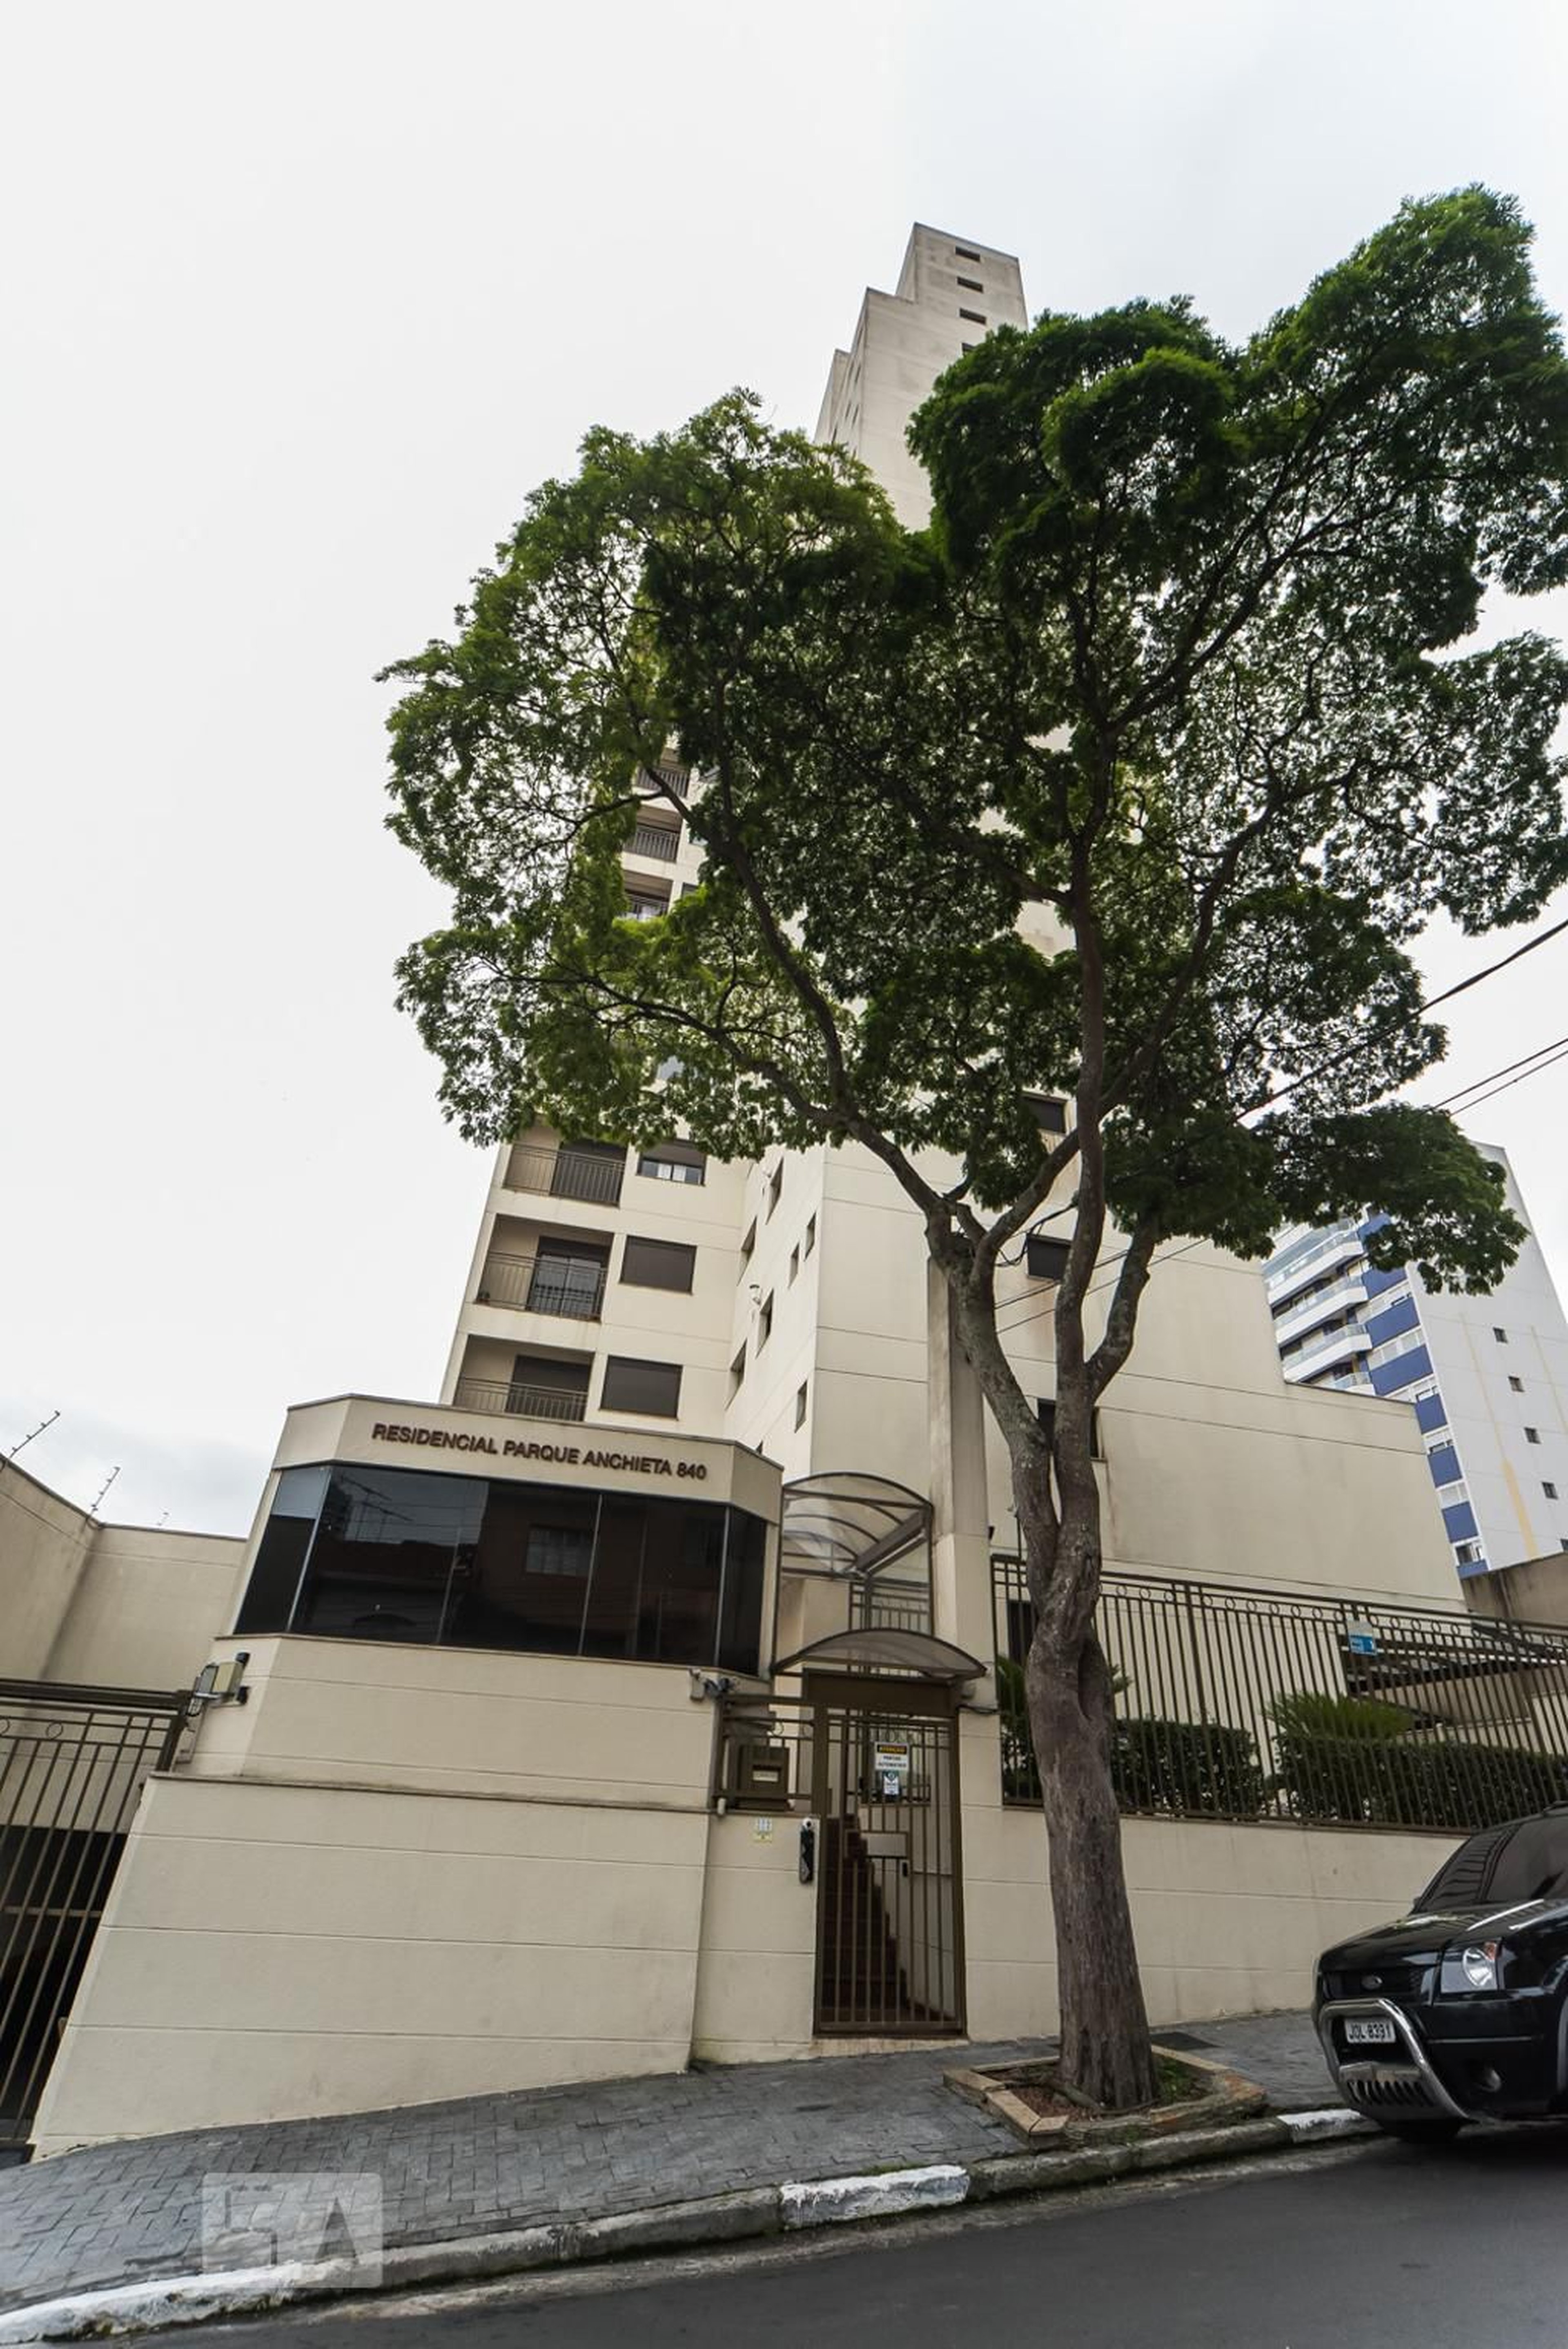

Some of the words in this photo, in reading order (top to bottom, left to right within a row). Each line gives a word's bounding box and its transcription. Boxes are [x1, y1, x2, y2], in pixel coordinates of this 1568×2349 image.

[372, 1423, 498, 1454] RESIDENCIAL
[503, 1440, 581, 1465] PARQUE
[582, 1450, 672, 1476] ANCHIETA
[677, 1462, 707, 1480] 840
